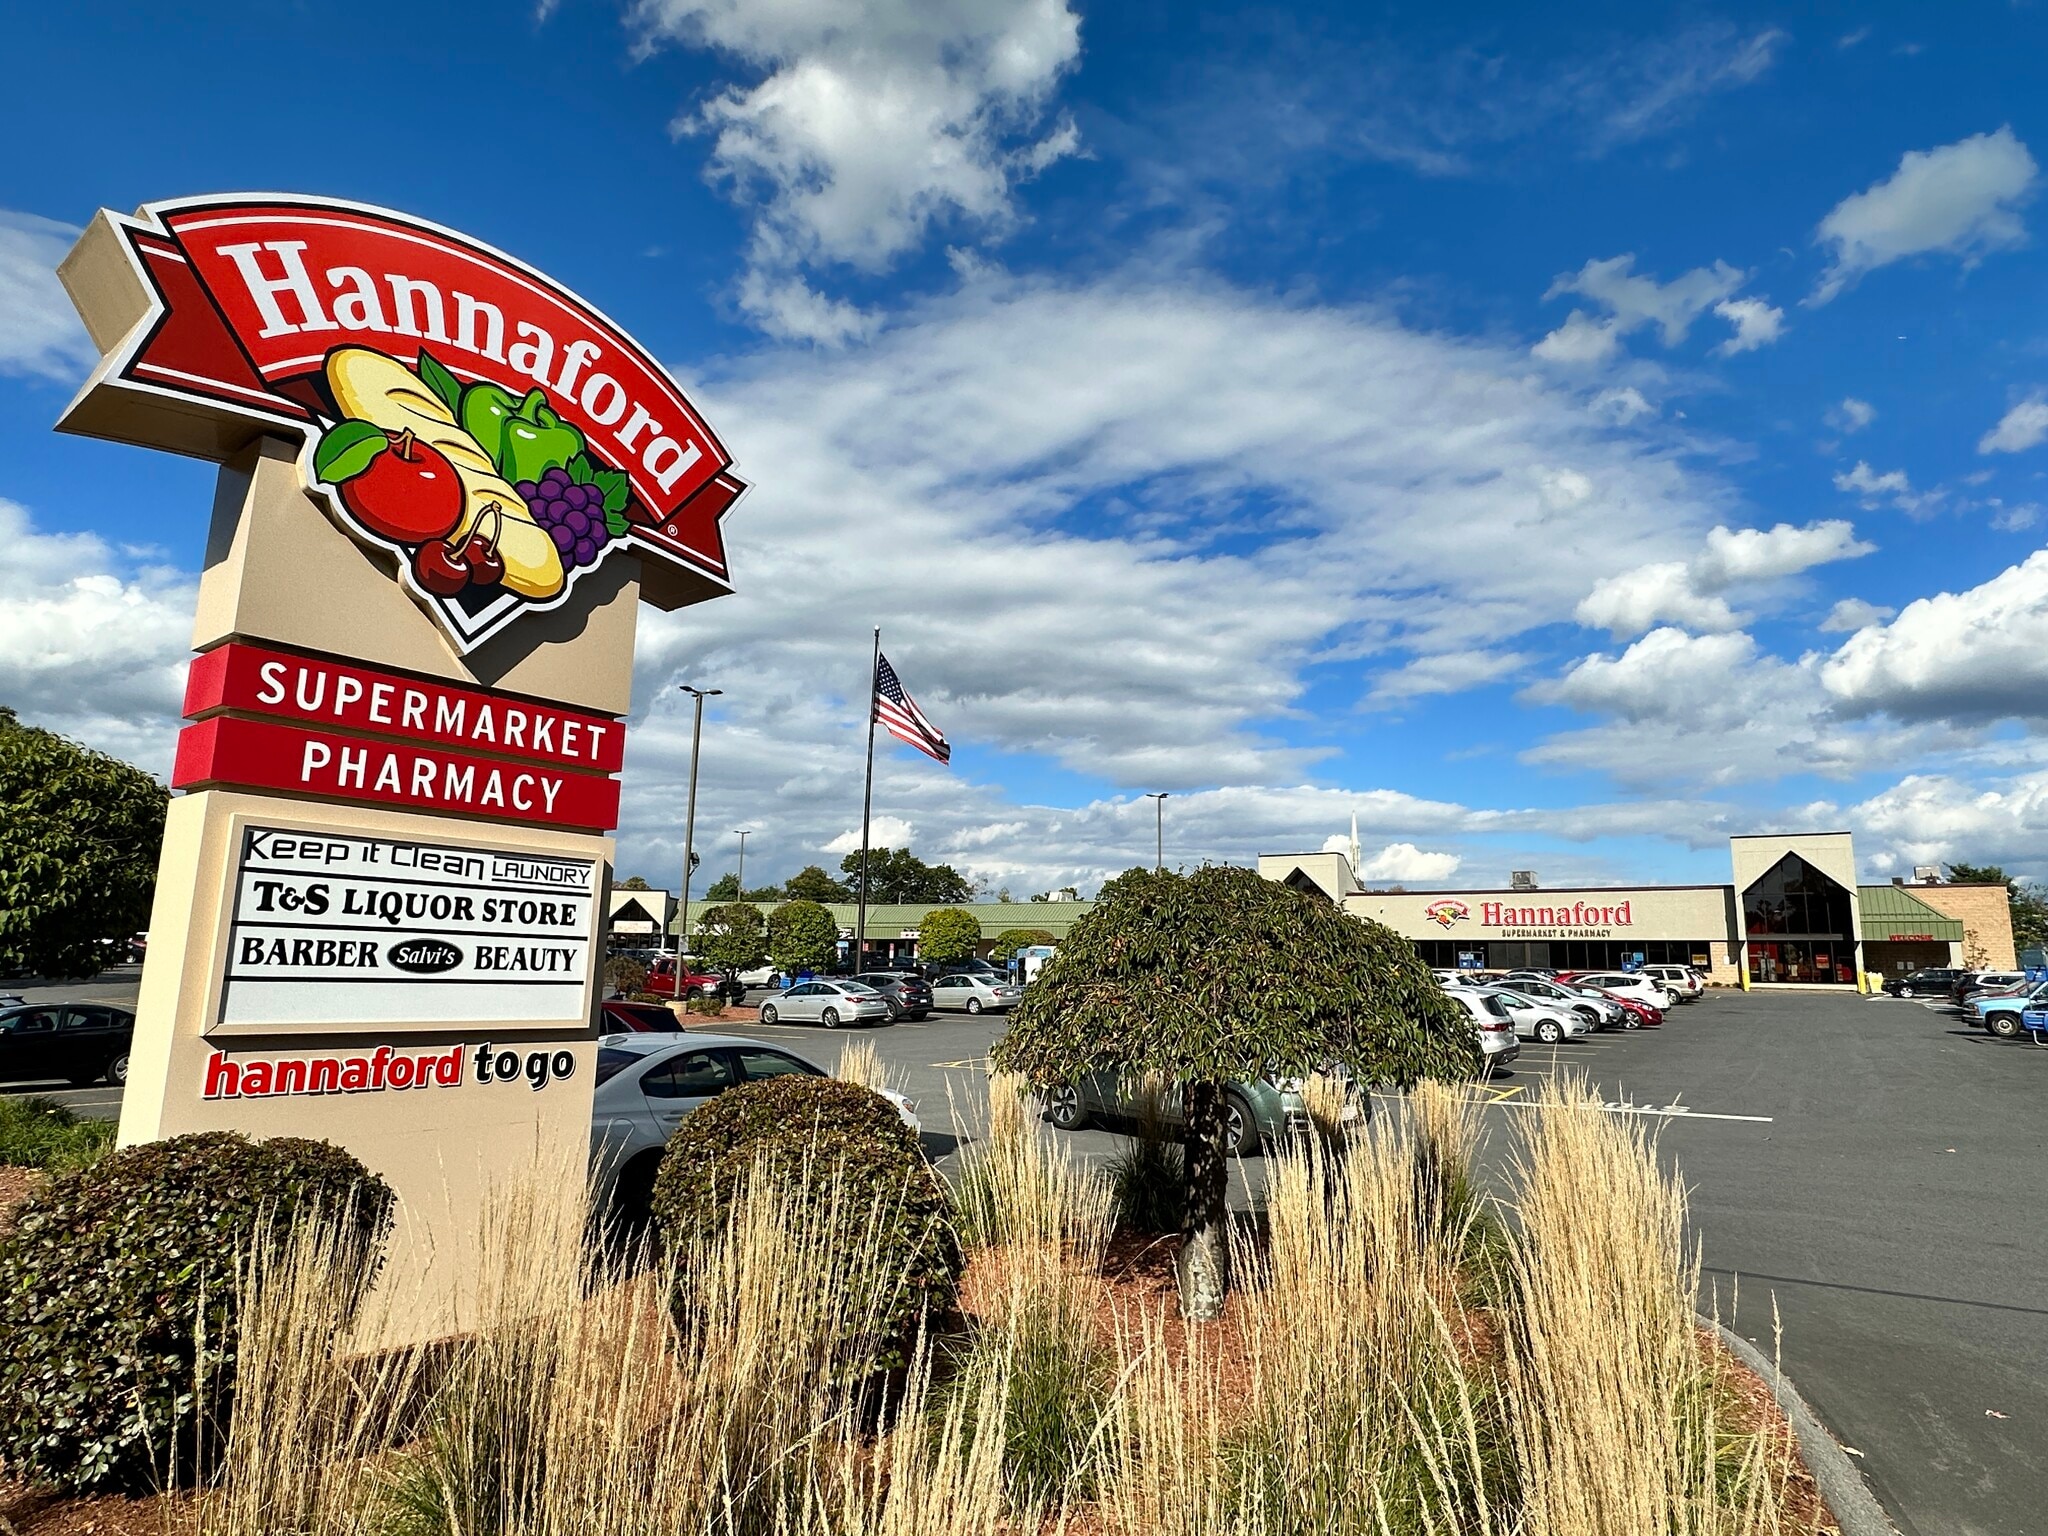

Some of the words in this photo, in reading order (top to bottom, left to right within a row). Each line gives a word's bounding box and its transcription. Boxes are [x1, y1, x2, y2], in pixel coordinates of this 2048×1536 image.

[216, 240, 703, 496] Hannaford
[256, 661, 606, 761] SUPERMARKET
[300, 740, 563, 814] PHARMACY
[246, 831, 349, 865] Keep
[362, 843, 380, 863] it
[391, 845, 484, 880] Clean
[492, 861, 591, 884] LAUNDRY
[253, 881, 330, 915] T&S
[342, 889, 475, 925] LIQUOR
[482, 898, 577, 926] STORE
[1480, 900, 1633, 927] Hannaford
[239, 937, 379, 968] BARBER
[396, 946, 456, 965] Salvi's
[474, 946, 578, 972] BEAUTY
[1501, 929, 1557, 938] SUPERMARKET
[1568, 929, 1612, 938] PHARMACY
[202, 1044, 466, 1098] hannaford
[473, 1042, 521, 1082] to
[524, 1047, 576, 1091] go
